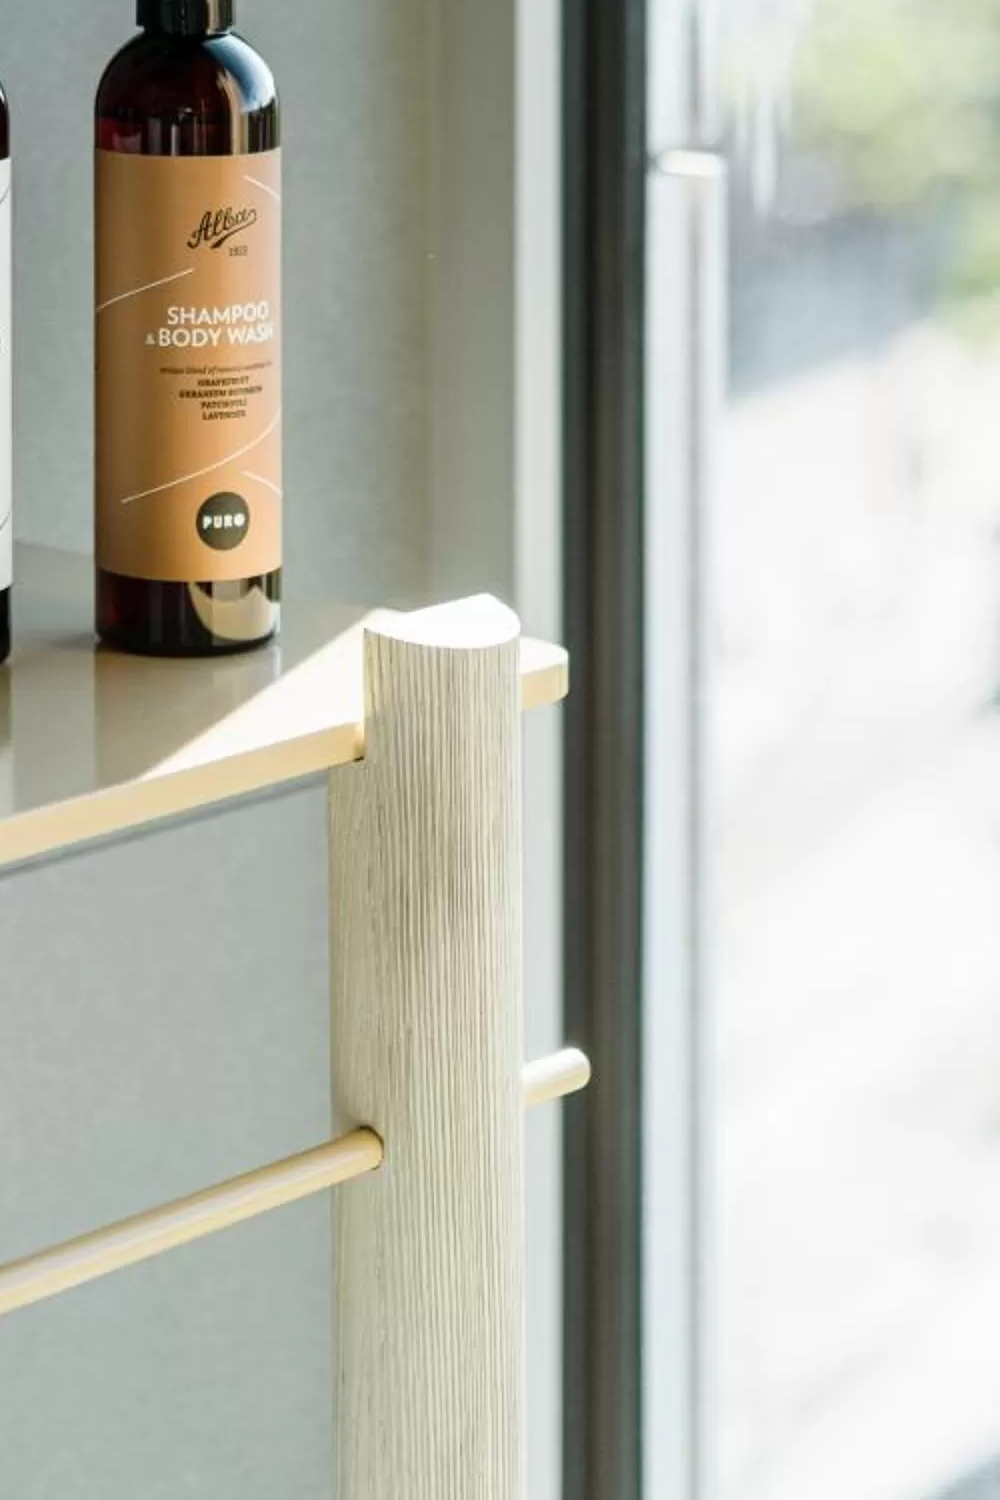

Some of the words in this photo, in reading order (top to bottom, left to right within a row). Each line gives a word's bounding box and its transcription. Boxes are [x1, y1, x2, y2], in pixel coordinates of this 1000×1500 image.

[167, 301, 270, 326] SHAMPOO
[227, 323, 274, 345] WASH
[203, 513, 245, 529] PURO
